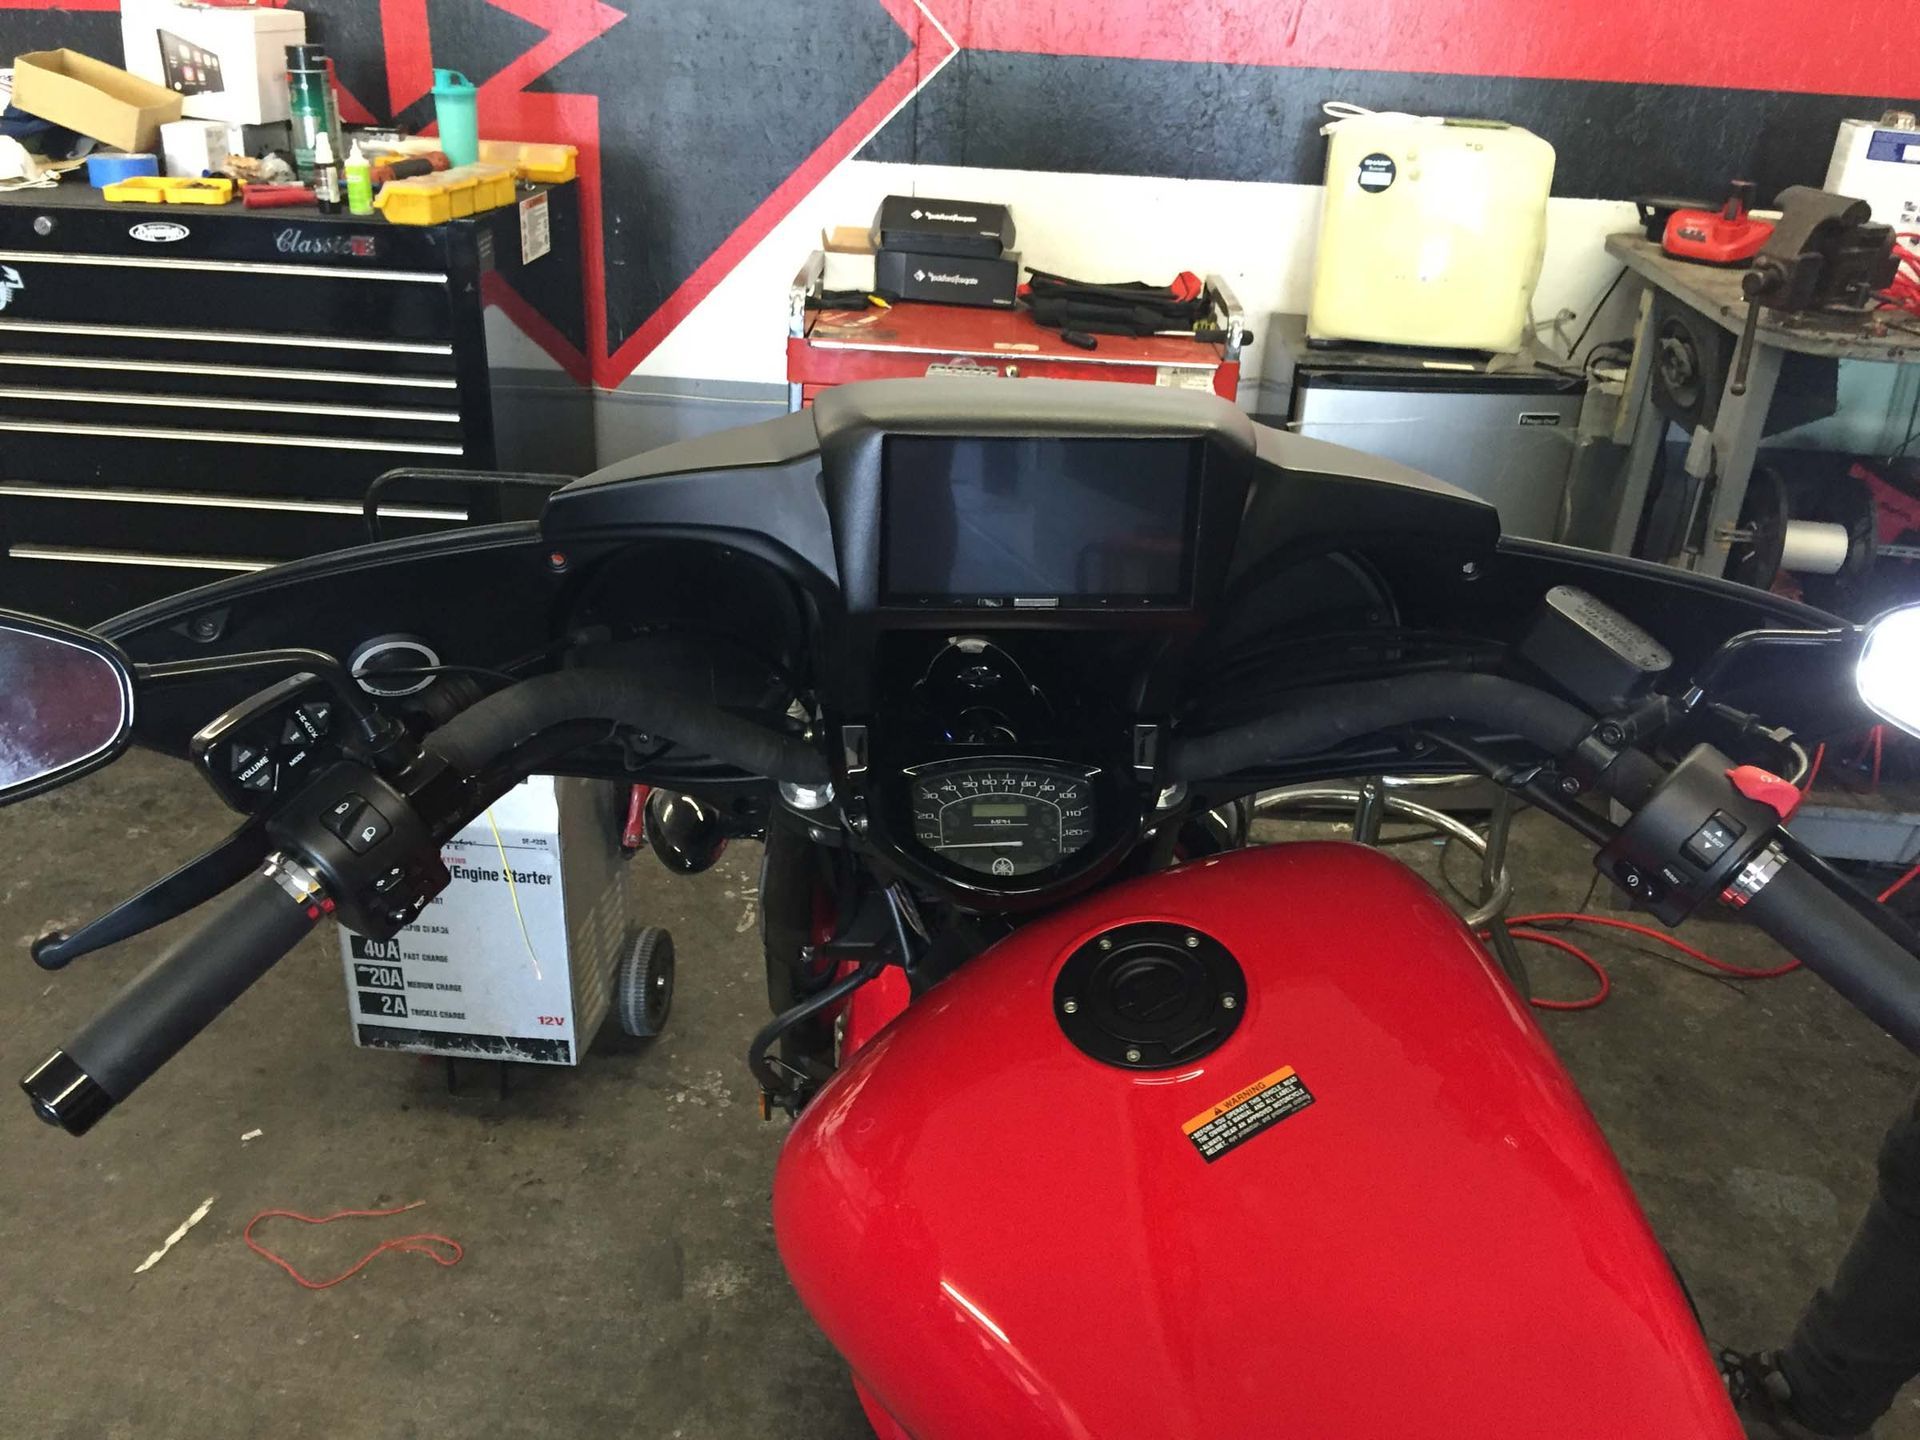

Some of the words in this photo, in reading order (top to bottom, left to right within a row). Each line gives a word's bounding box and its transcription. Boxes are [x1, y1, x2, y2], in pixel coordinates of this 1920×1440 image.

[238, 756, 269, 781] VOLUME
[503, 868, 553, 885] Starter
[403, 952, 420, 961] FAST
[369, 966, 403, 987] 20A
[407, 980, 434, 989] MEDIUM
[436, 982, 462, 992] CHARGE
[381, 995, 406, 1015] 2A
[411, 1008, 438, 1018] TRICKLE
[537, 1015, 565, 1026] 12V
[1223, 1081, 1265, 1108] WARNING
